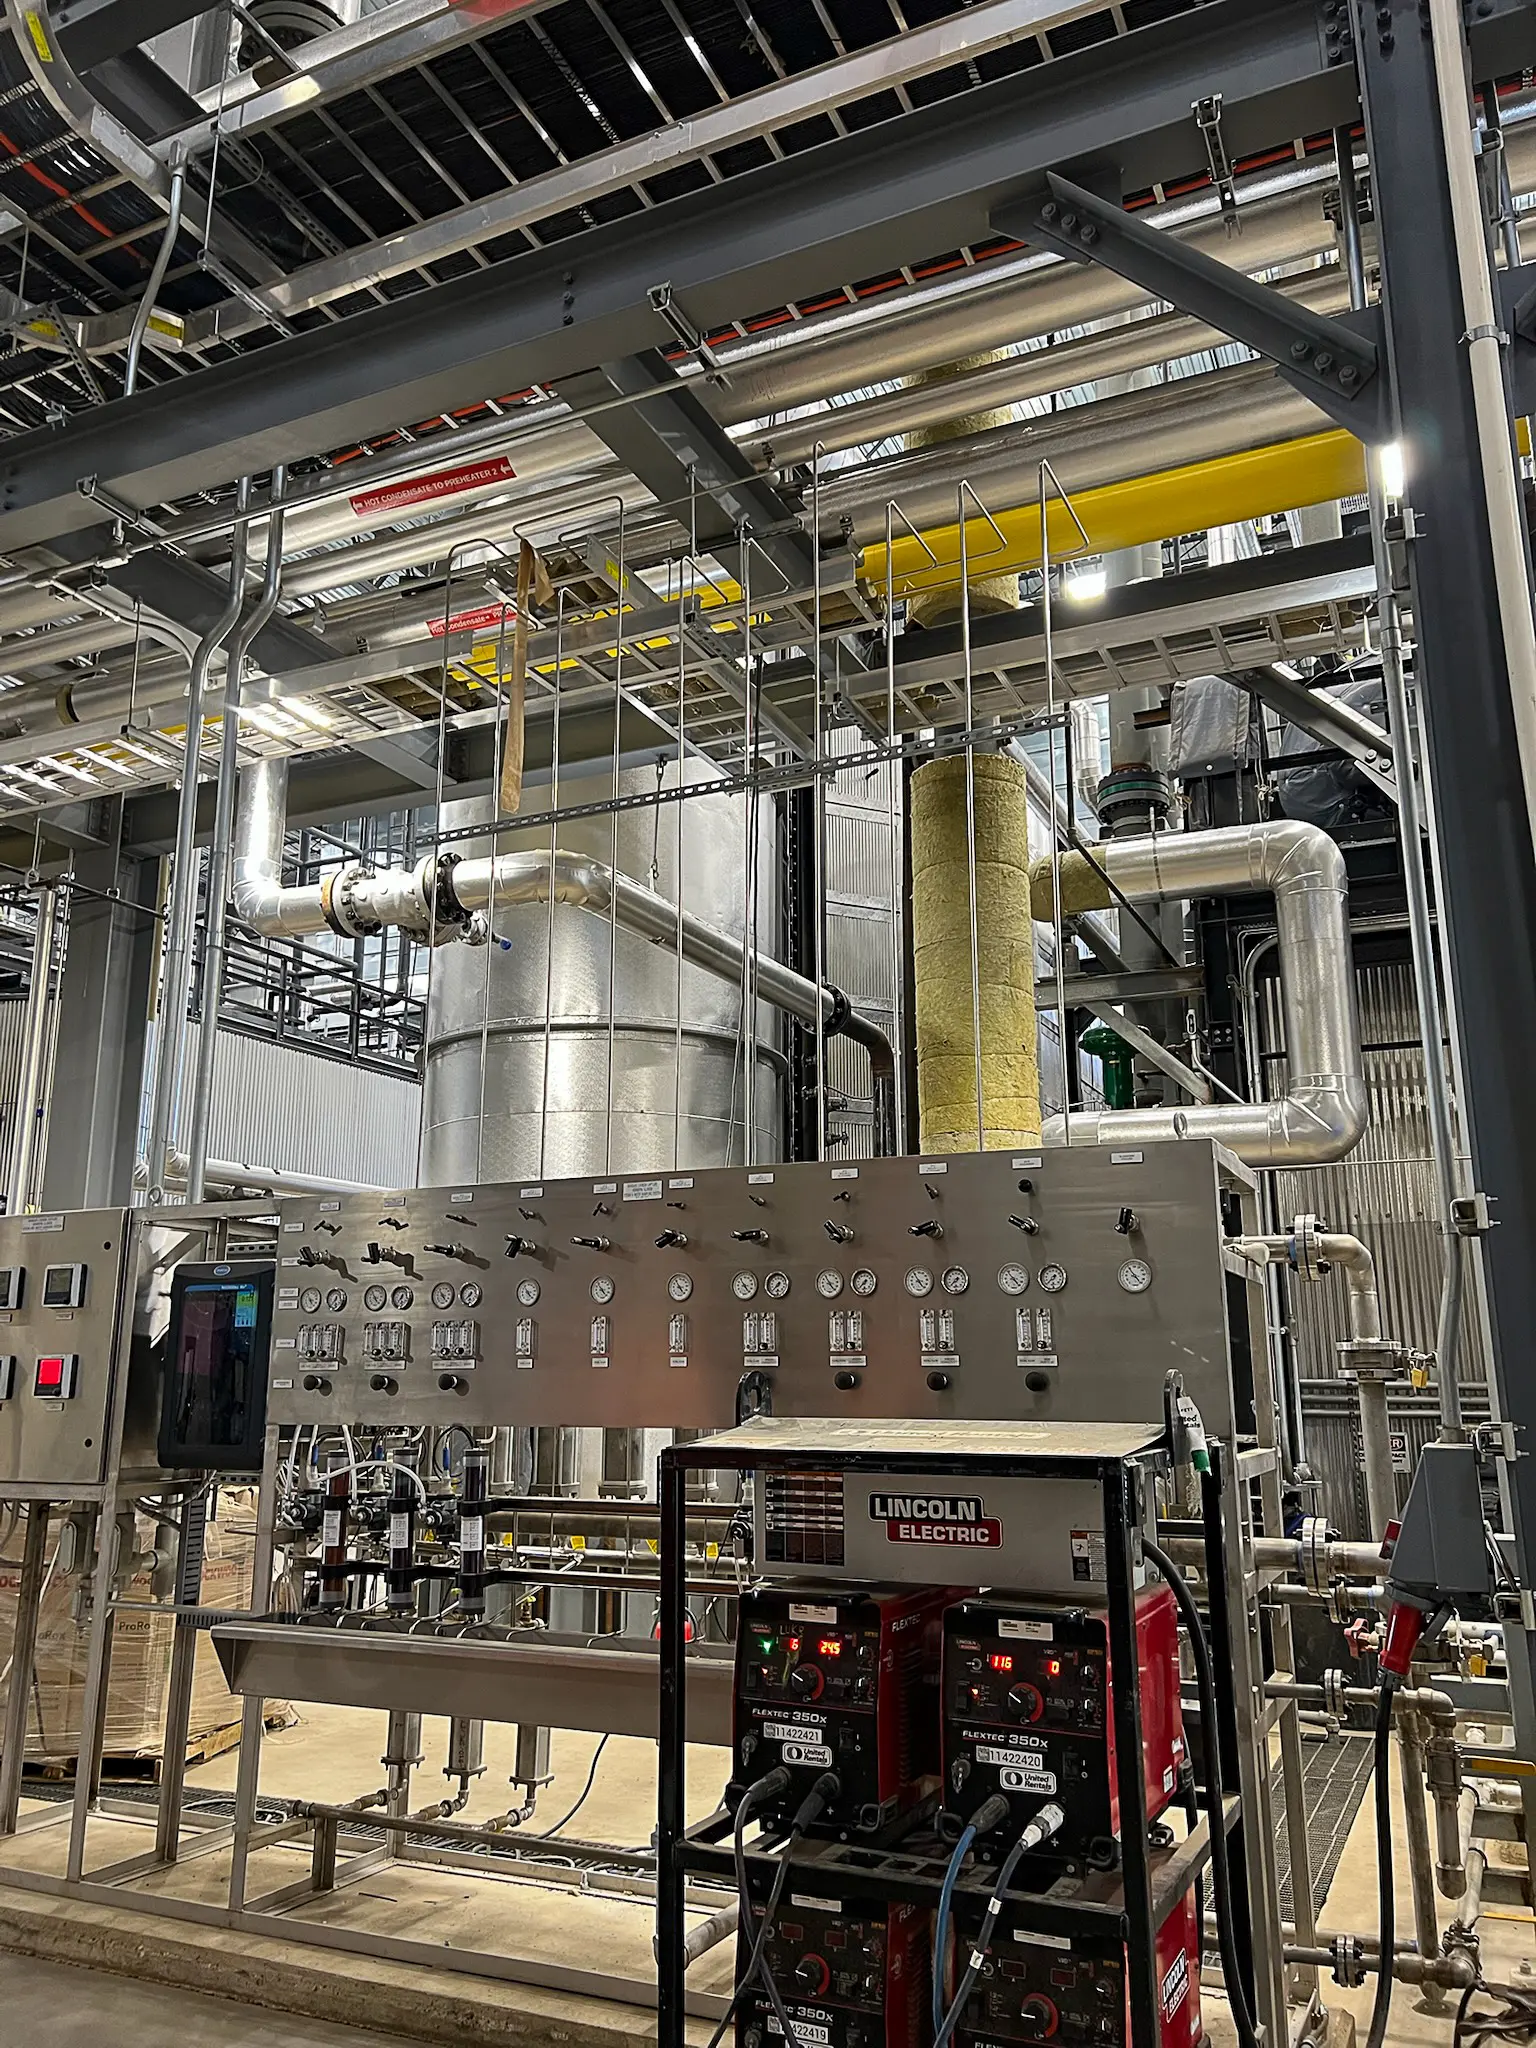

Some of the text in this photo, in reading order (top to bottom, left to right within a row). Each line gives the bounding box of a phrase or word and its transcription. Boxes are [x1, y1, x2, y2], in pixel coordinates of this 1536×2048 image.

[364, 468, 498, 508] HOT CONDENSATE TO PREHEATER 2
[875, 1497, 976, 1521] LINCOLN
[899, 1524, 990, 1543] ELECTRIC
[118, 1621, 151, 1631] ProRo
[993, 1655, 1012, 1669] 116
[752, 1708, 789, 1719] FLEXTEC
[776, 1726, 819, 1741] 11422421
[962, 1730, 1004, 1741] FLEXTEC
[803, 1748, 826, 1757] United
[990, 1750, 1041, 1767] 11422420
[803, 1755, 828, 1763] Rentals
[1024, 1773, 1049, 1783] United
[1024, 1781, 1052, 1790] Rentals
[791, 2022, 826, 2040] 422419
